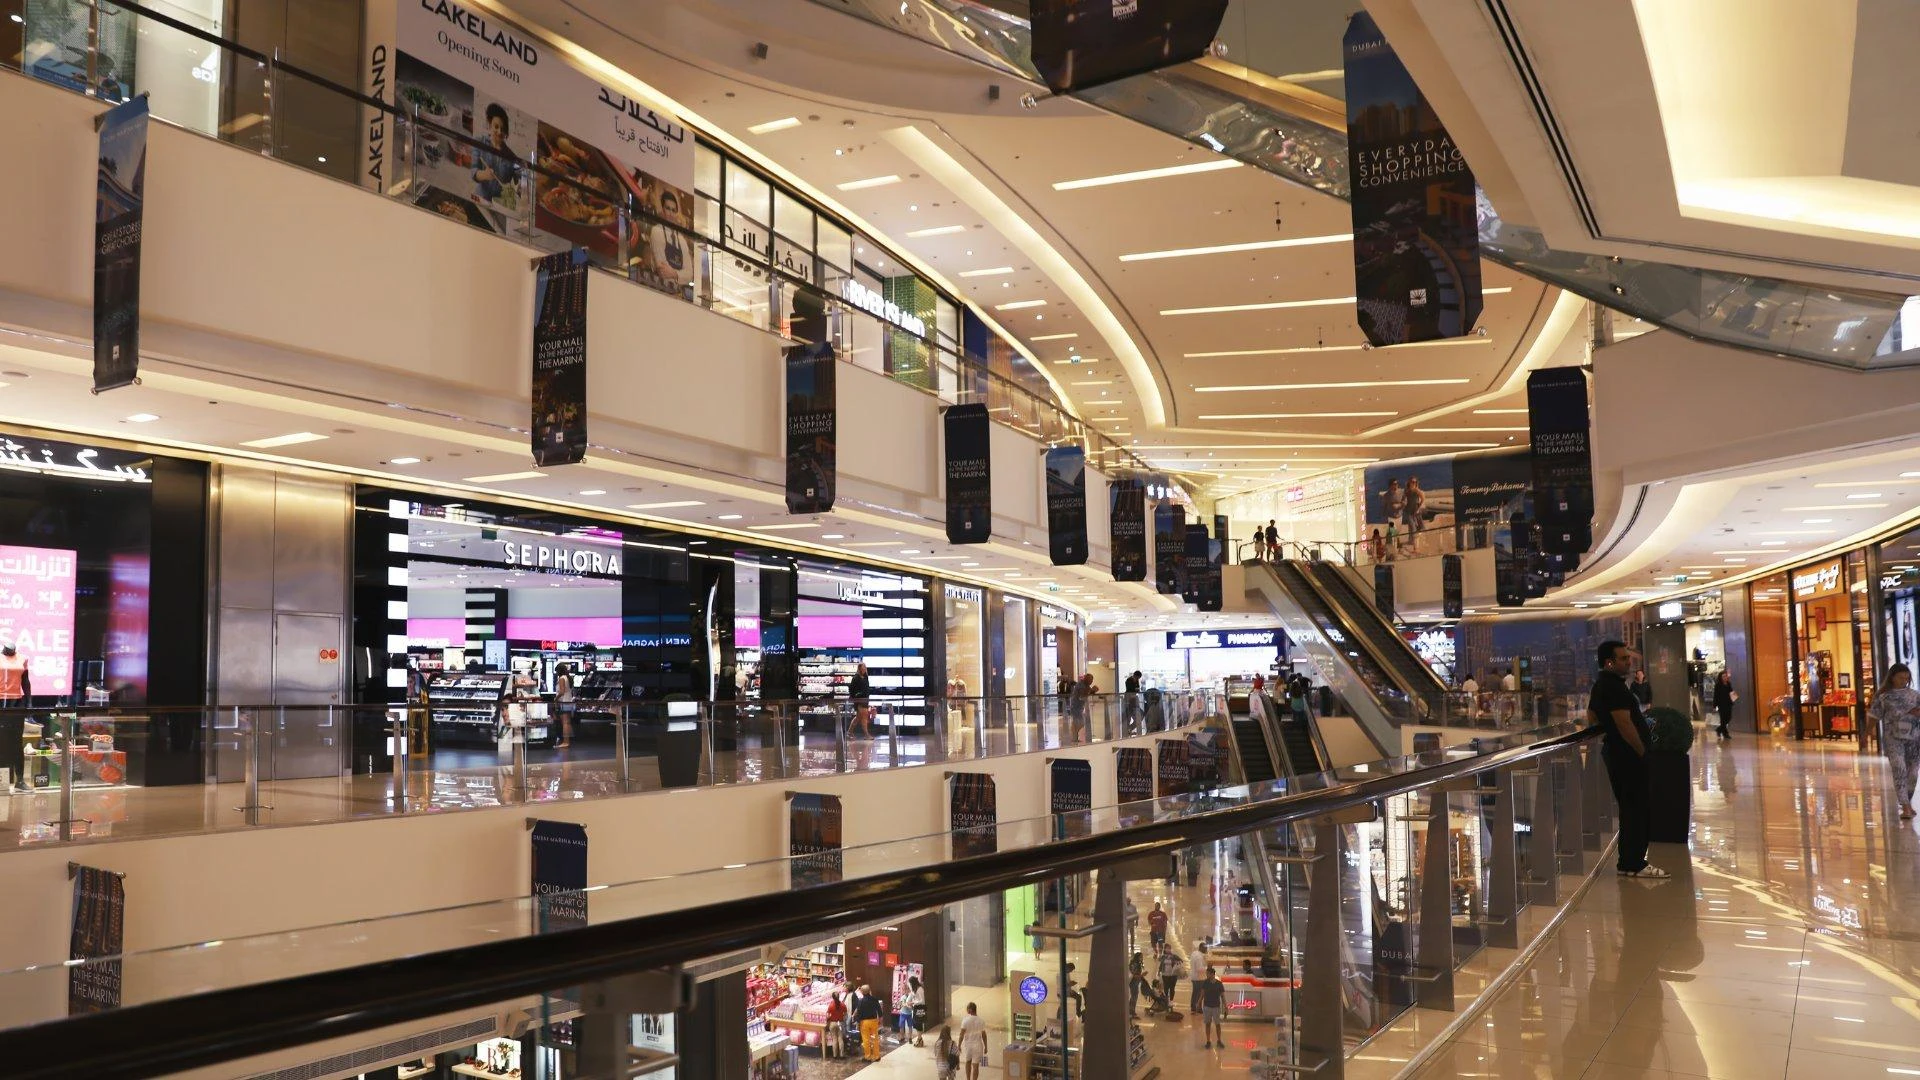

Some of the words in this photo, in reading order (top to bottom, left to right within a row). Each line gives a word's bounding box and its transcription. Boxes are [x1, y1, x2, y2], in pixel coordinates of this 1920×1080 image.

[1352, 40, 1381, 53] DUBAI
[438, 30, 490, 70] Opening
[492, 58, 520, 84] Soon
[1358, 137, 1450, 163] EVERYDA
[1359, 148, 1463, 177] SHOPPING
[1359, 160, 1465, 188] CONVENIENCE
[539, 338, 562, 352] YOUR
[563, 335, 584, 348] MALL
[539, 358, 553, 369] THE
[553, 353, 584, 367] MARINA
[788, 412, 832, 422] EVERYDAY
[788, 419, 833, 430] SHOPPING
[1536, 433, 1561, 441] YOUR
[1561, 431, 1584, 439] MALL
[1537, 447, 1551, 455] THE
[1551, 445, 1584, 454] MARINA
[949, 460, 968, 468] YOUR
[968, 458, 986, 466] MALL
[960, 470, 987, 478] MARINA
[503, 541, 621, 575] SEPHORA
[0, 627, 70, 653] SALE
[1227, 632, 1275, 645] PHARMACY
[952, 813, 973, 821] YOUR
[974, 813, 994, 822] MALL
[534, 882, 560, 895] YOUR
[556, 896, 576, 907] HEART
[576, 898, 586, 908] OF
[550, 905, 586, 920] MARINA
[97, 959, 122, 979] MALL
[73, 979, 88, 997] THE
[87, 983, 121, 1007] MARINA
